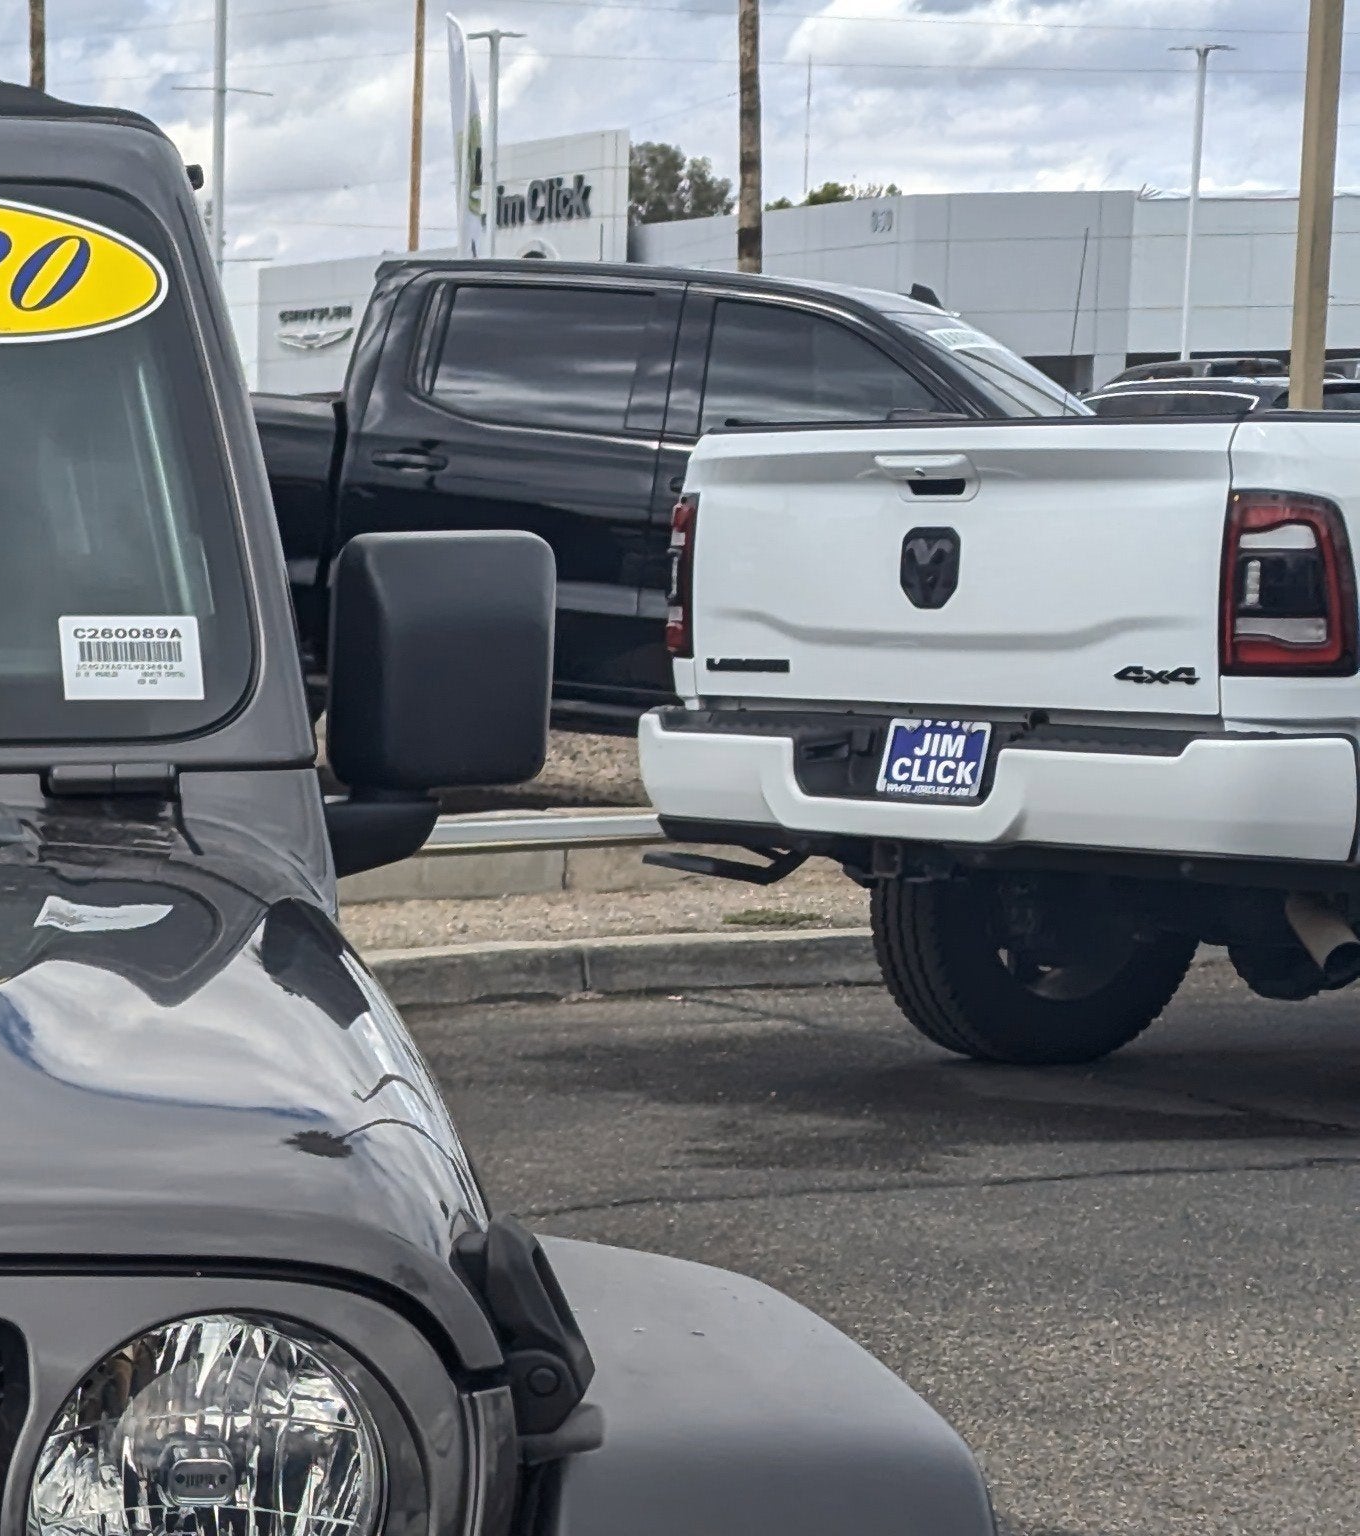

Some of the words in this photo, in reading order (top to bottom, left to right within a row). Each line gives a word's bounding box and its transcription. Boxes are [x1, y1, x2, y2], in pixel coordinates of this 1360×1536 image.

[481, 184, 526, 229] im
[528, 173, 592, 223] Click
[73, 628, 182, 639] C260089A
[1113, 666, 1200, 685] 4x4
[913, 732, 966, 758] JIM
[892, 757, 976, 785] CLICK
